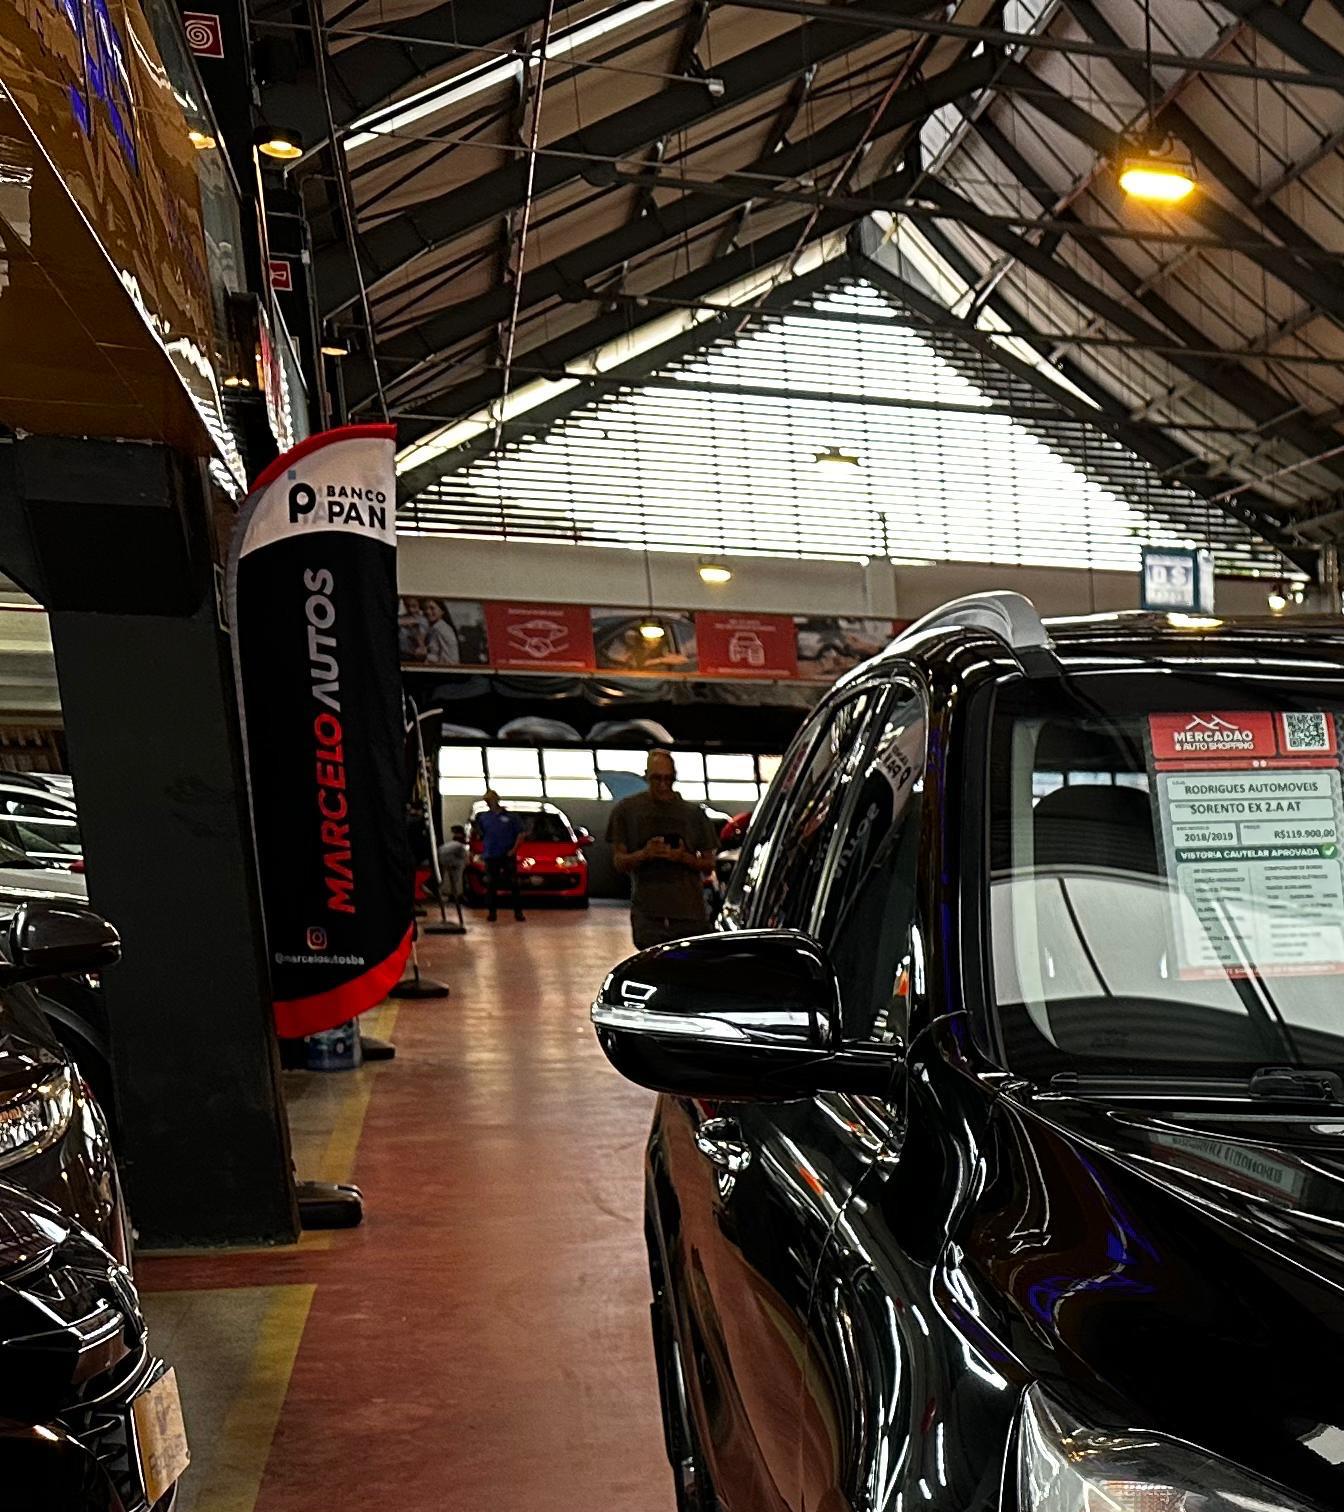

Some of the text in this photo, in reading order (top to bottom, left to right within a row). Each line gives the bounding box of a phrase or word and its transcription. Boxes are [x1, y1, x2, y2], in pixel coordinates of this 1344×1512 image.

[326, 484, 387, 504] BANCO
[327, 500, 387, 530] PAN
[1183, 742, 1208, 751] AUTO
[1184, 781, 1319, 795] RODRIGUES AUTOMOVEIS
[1190, 803, 1245, 815] SORENTO
[1248, 802, 1263, 813] EX
[1286, 801, 1302, 811] AT
[1184, 831, 1234, 843] 2018/2019
[1274, 829, 1335, 840] R$119.900,00
[1180, 847, 1320, 860] VISTORIA CAUTELAR APROVADA
